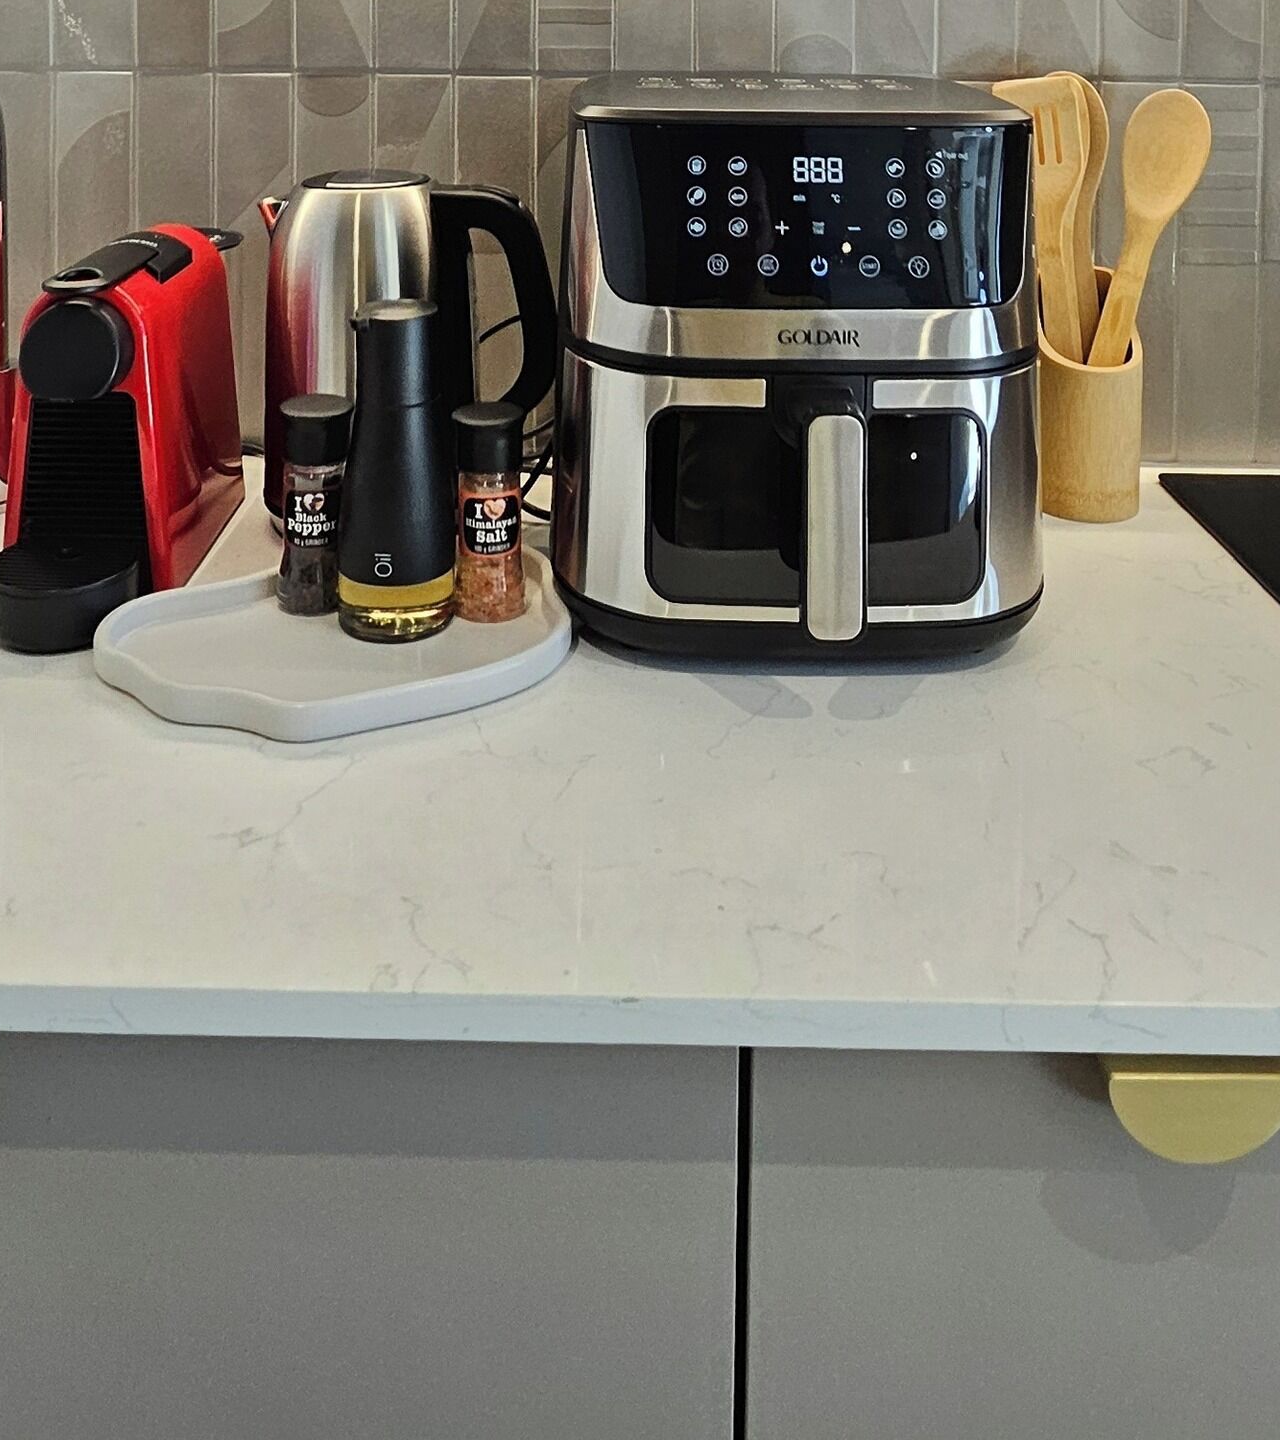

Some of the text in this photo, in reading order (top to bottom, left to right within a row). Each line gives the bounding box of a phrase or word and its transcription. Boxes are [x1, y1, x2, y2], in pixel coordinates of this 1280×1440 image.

[778, 328, 861, 348] GOLDAIR
[294, 496, 303, 512] I
[474, 502, 484, 519] I
[295, 512, 327, 523] Black
[465, 515, 518, 529] Himalayan
[287, 517, 337, 536] Pepper
[476, 527, 508, 544] Salt
[374, 553, 393, 578] Oil
